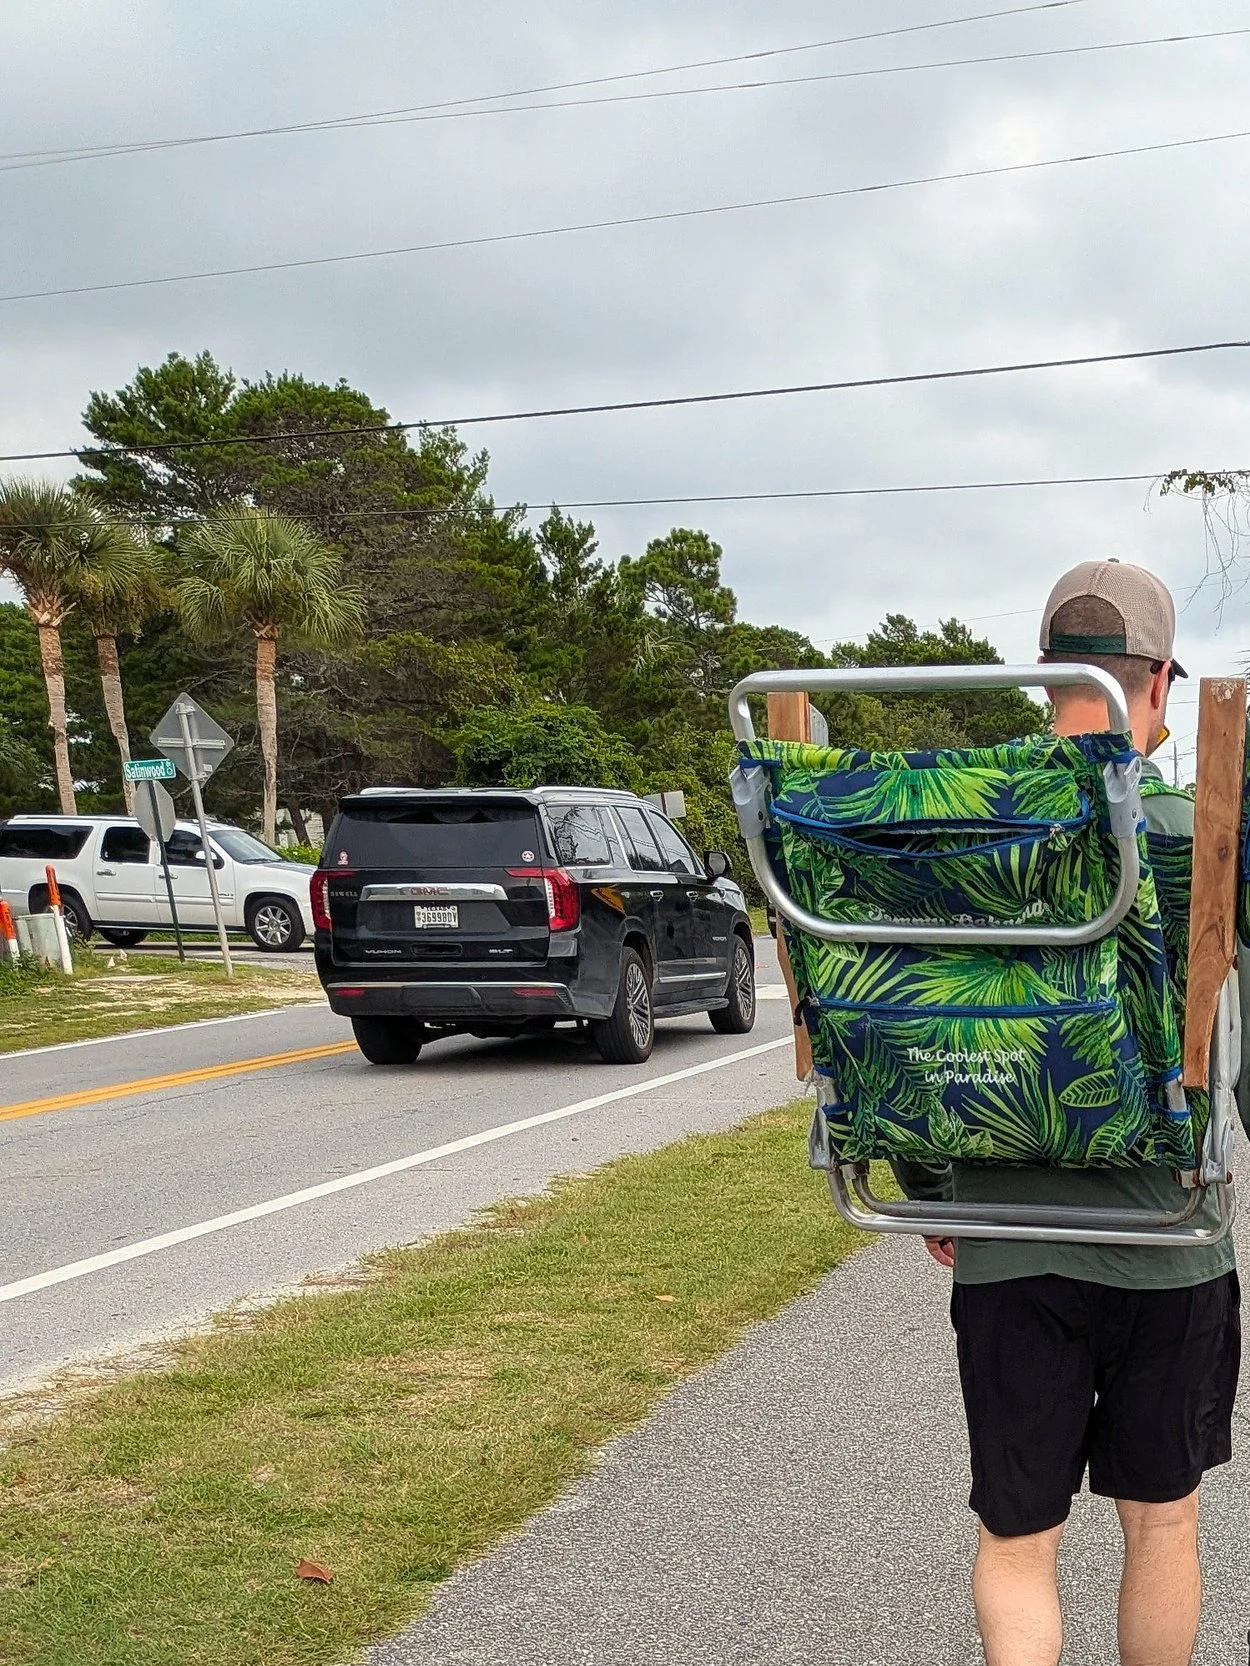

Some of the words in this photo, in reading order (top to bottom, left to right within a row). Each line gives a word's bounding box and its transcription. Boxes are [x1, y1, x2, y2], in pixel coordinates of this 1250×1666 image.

[125, 761, 166, 779] Satinwood
[411, 886, 449, 896] GMC
[907, 1047, 935, 1062] The
[936, 1048, 991, 1064] Coolest
[993, 1048, 1026, 1066] Spot
[924, 1070, 944, 1083] in
[944, 1069, 1016, 1086] Paradise
